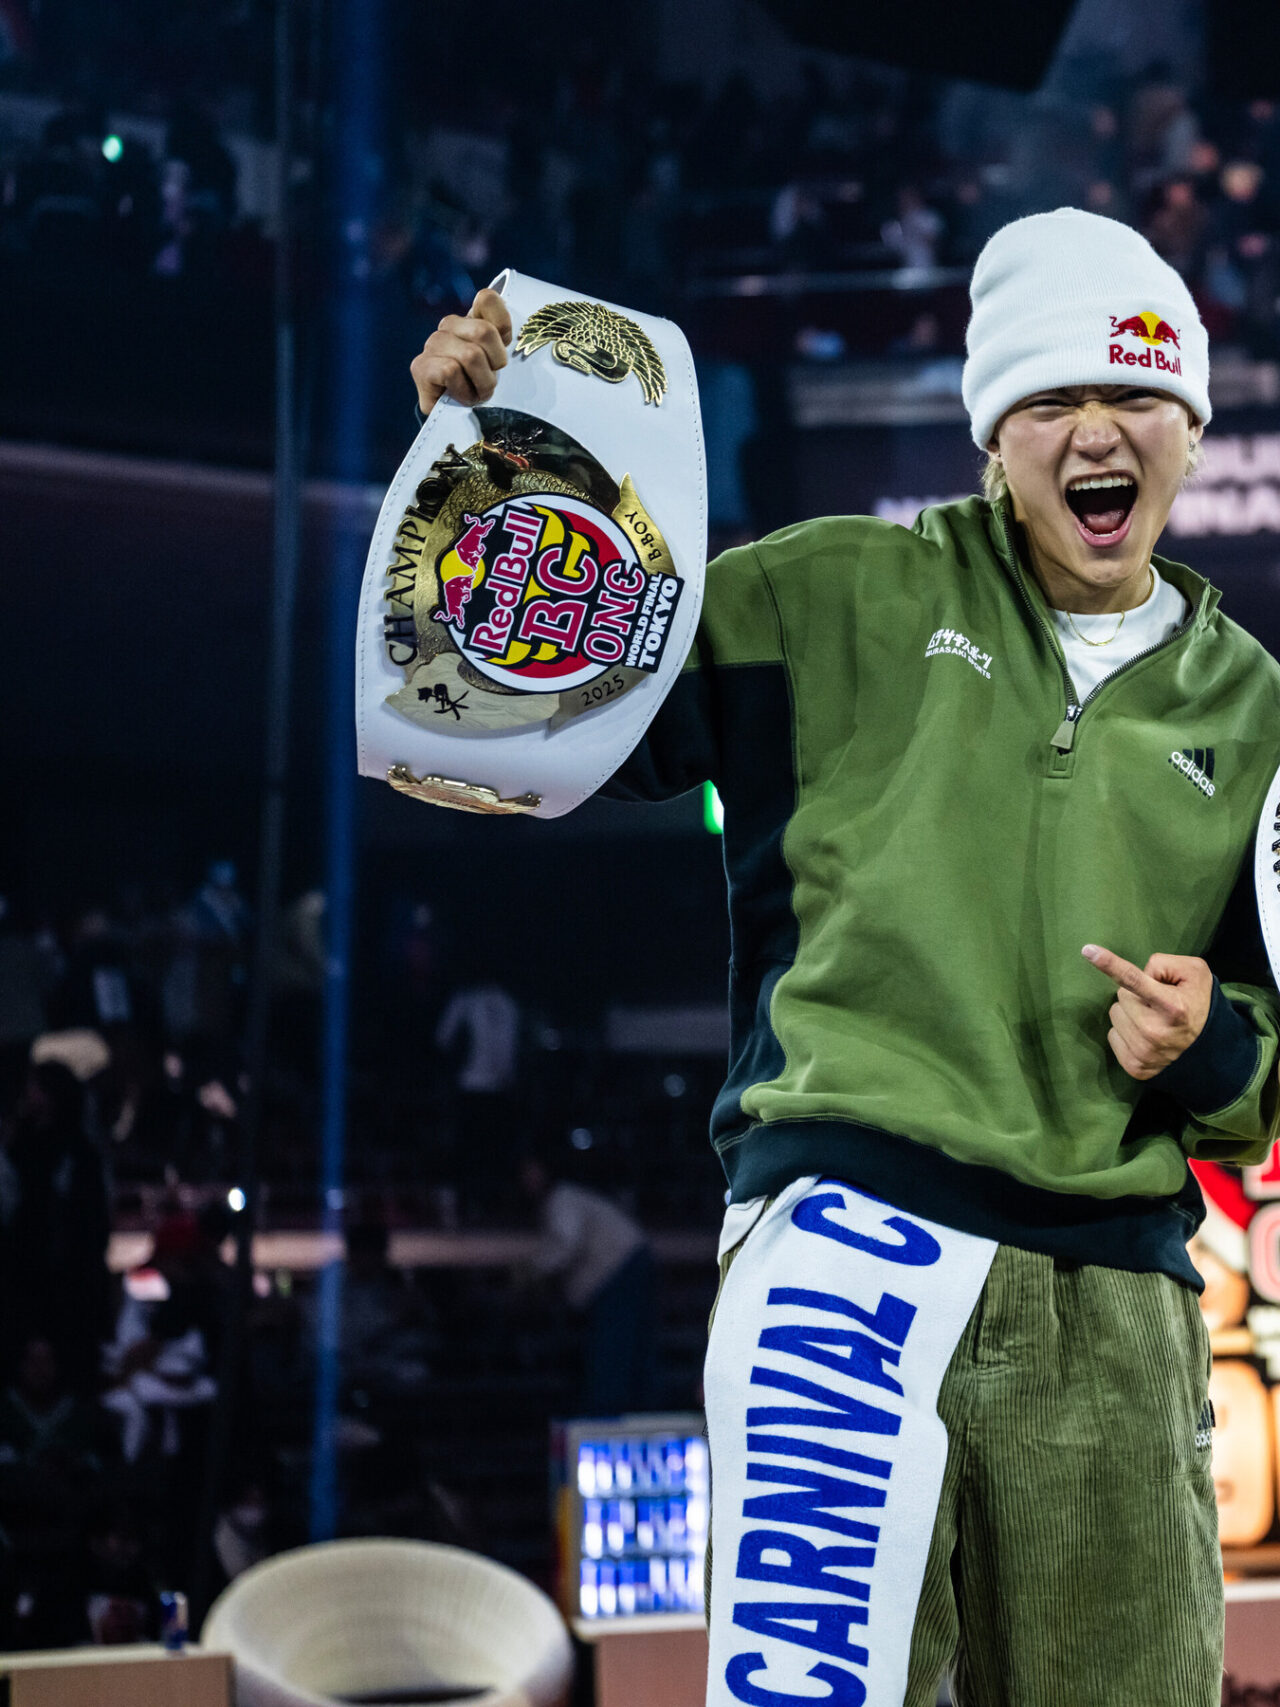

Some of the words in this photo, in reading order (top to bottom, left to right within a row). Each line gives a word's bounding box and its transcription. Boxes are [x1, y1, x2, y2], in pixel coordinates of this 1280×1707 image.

[1109, 344, 1152, 368] Red
[1154, 349, 1182, 377] Bull
[384, 443, 470, 667] CHAMPION
[492, 509, 544, 583] Bull
[625, 510, 662, 562] B-BOY
[470, 578, 524, 653] Red
[517, 546, 600, 653] BC
[583, 561, 647, 662] ONE
[625, 616, 650, 667] WORLD
[643, 572, 663, 616] FINAL
[638, 576, 679, 669] TOKYO
[581, 674, 625, 706] 2025
[1171, 751, 1216, 797] adidas
[791, 1176, 942, 1267] C
[725, 1287, 918, 1707] CARNIVAL
